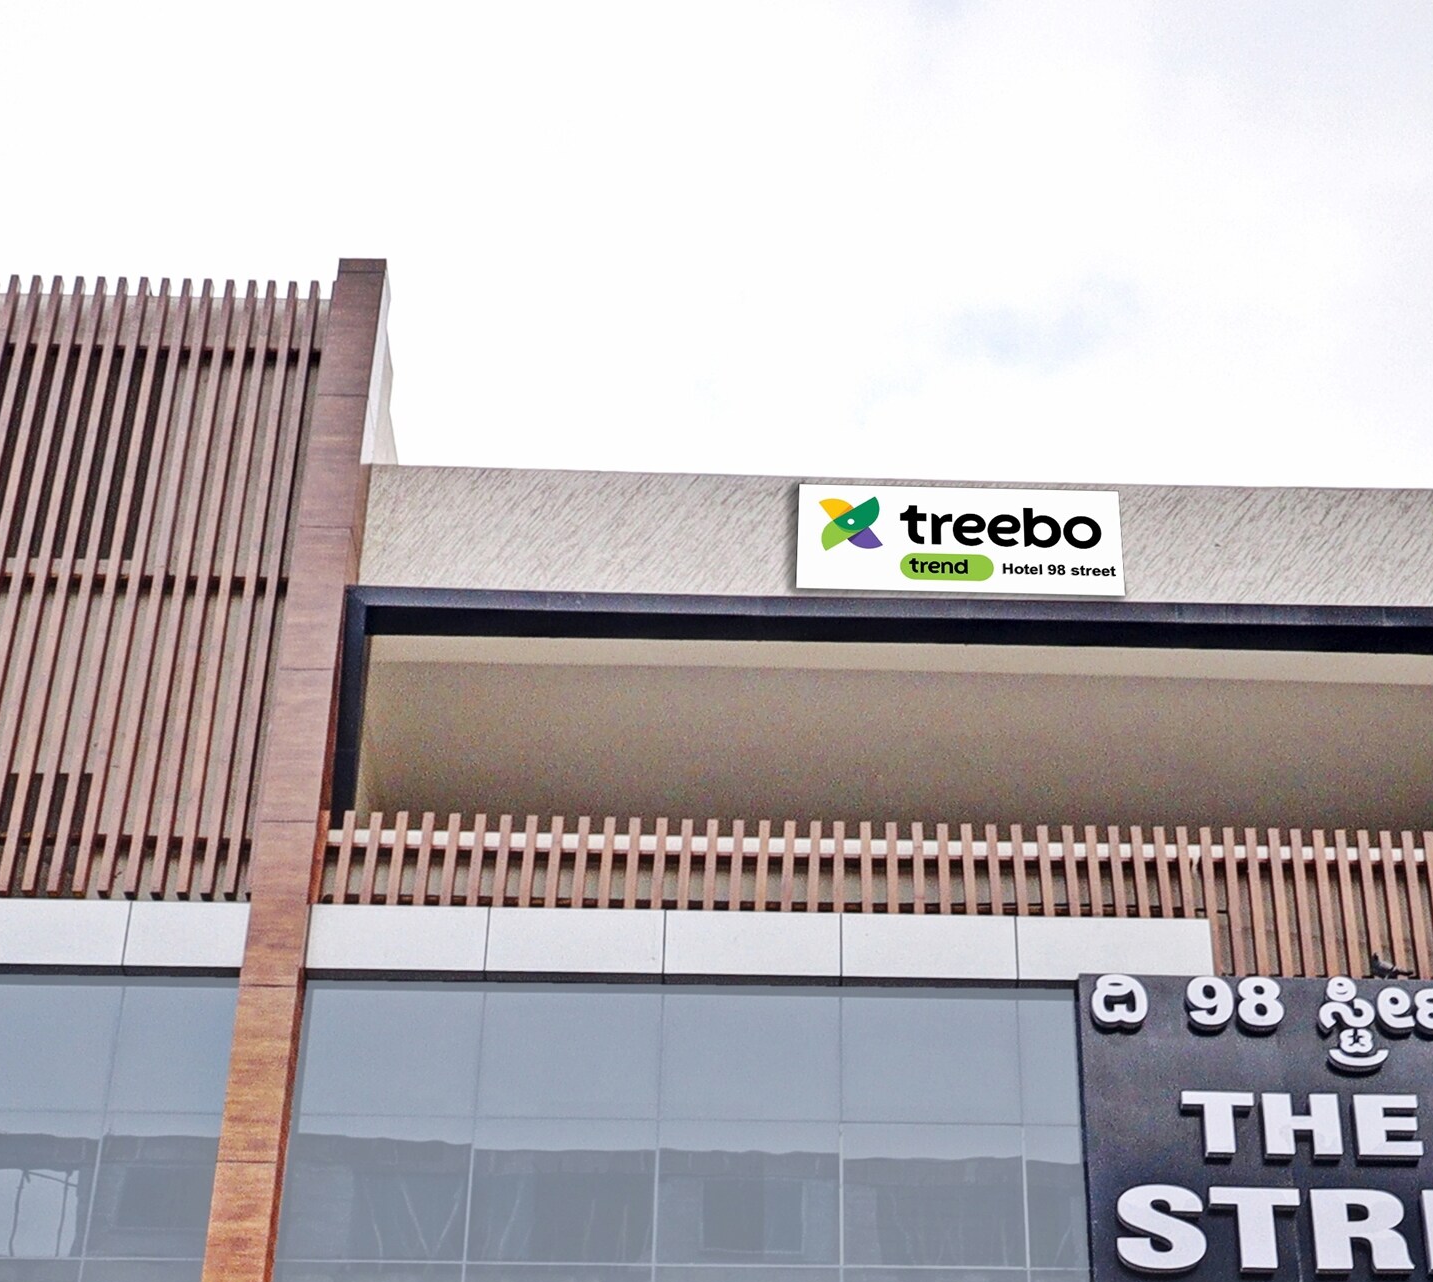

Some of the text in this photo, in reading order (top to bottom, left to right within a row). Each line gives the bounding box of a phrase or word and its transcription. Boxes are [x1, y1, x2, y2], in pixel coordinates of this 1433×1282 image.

[899, 504, 1103, 550] treebo
[908, 557, 969, 575] trend
[1001, 562, 1117, 577] Hotel 98 street
[1090, 973, 1149, 1027] ದಿ
[1185, 975, 1286, 1031] 98
[1179, 1089, 1425, 1161] THE
